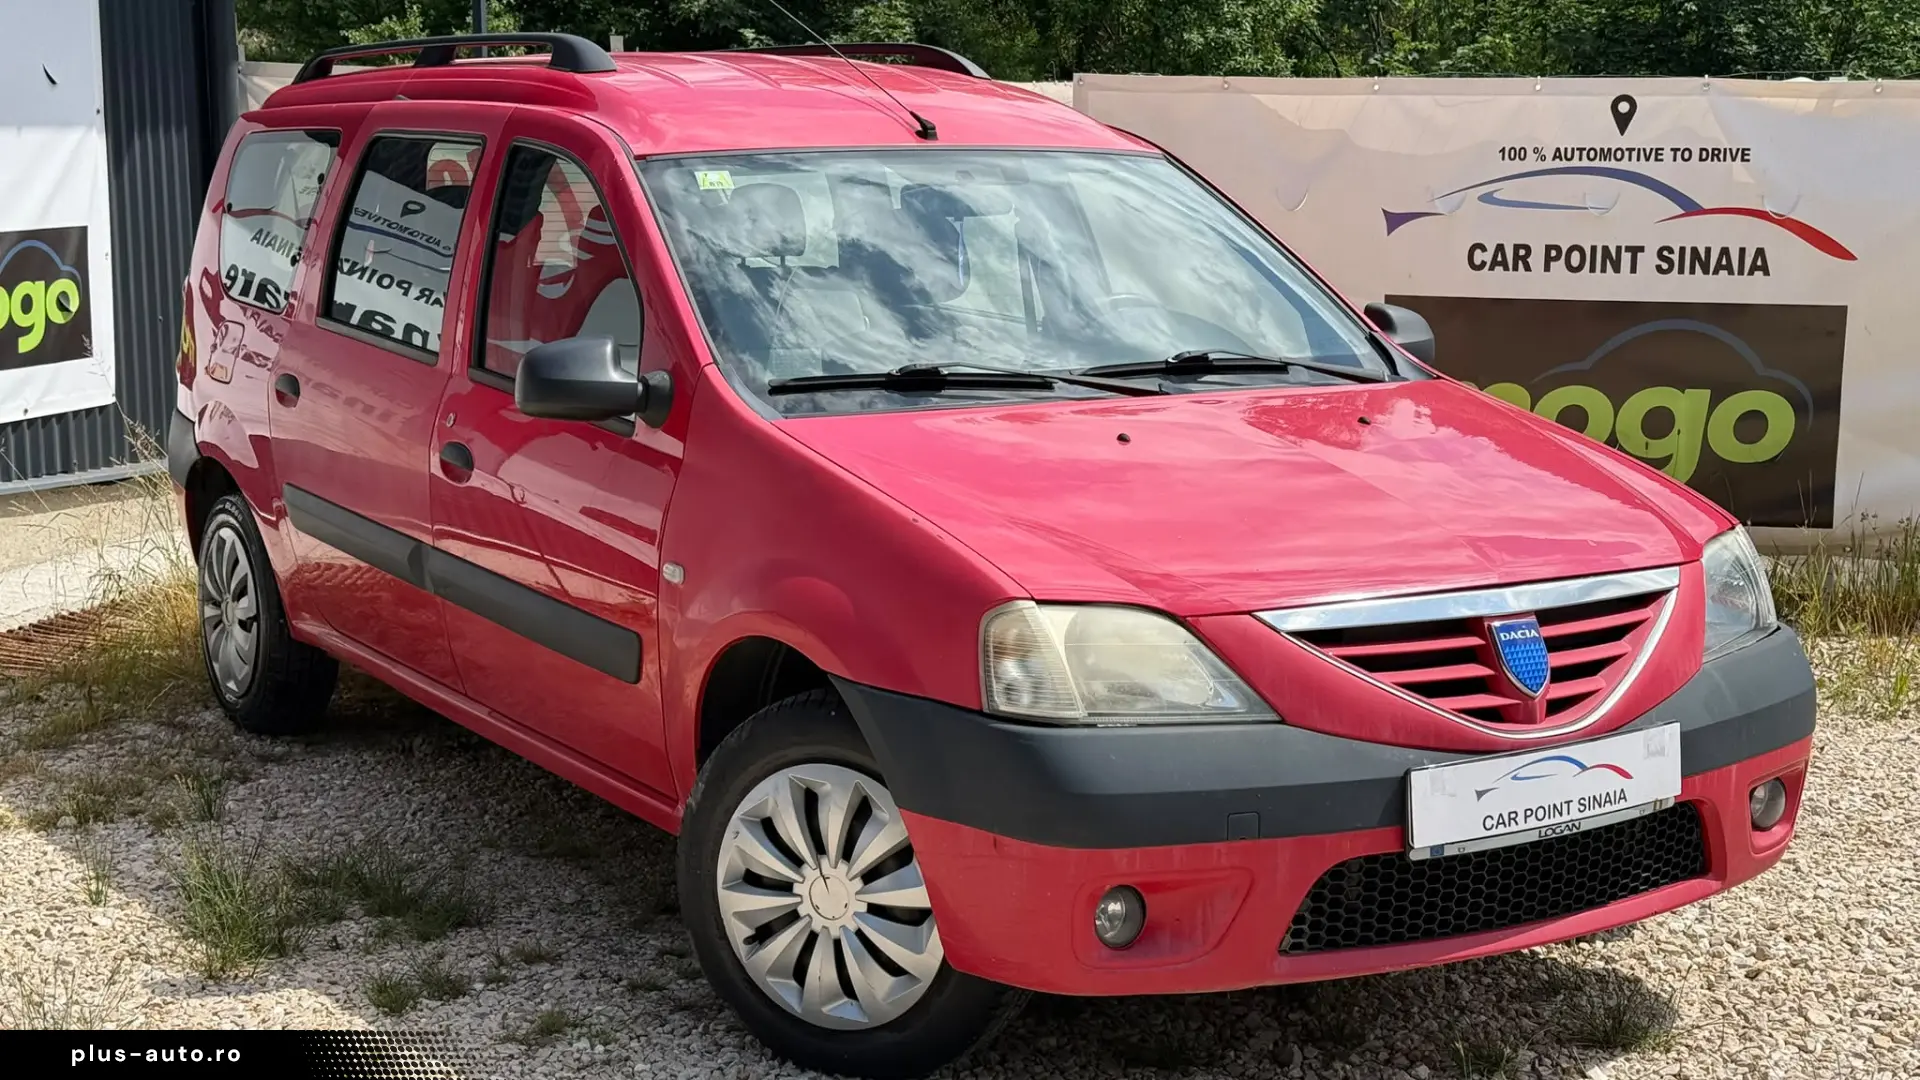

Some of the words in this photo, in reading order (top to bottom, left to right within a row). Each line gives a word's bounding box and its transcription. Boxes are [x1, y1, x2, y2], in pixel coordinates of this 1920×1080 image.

[1498, 146, 1527, 162] 100
[1532, 146, 1547, 162] %
[1551, 146, 1665, 163] AUTOMOTIVE
[1670, 147, 1694, 162] TO
[1698, 147, 1752, 163] DRIVE
[1466, 242, 1533, 273] CAR
[1543, 243, 1646, 275] POINT
[1654, 245, 1771, 277] SINAIA
[1500, 628, 1540, 641] DACIA
[1482, 813, 1519, 832] CAR
[1523, 799, 1574, 825] POINT
[1577, 787, 1628, 814] SINAIA
[1537, 820, 1582, 839] LOGAN
